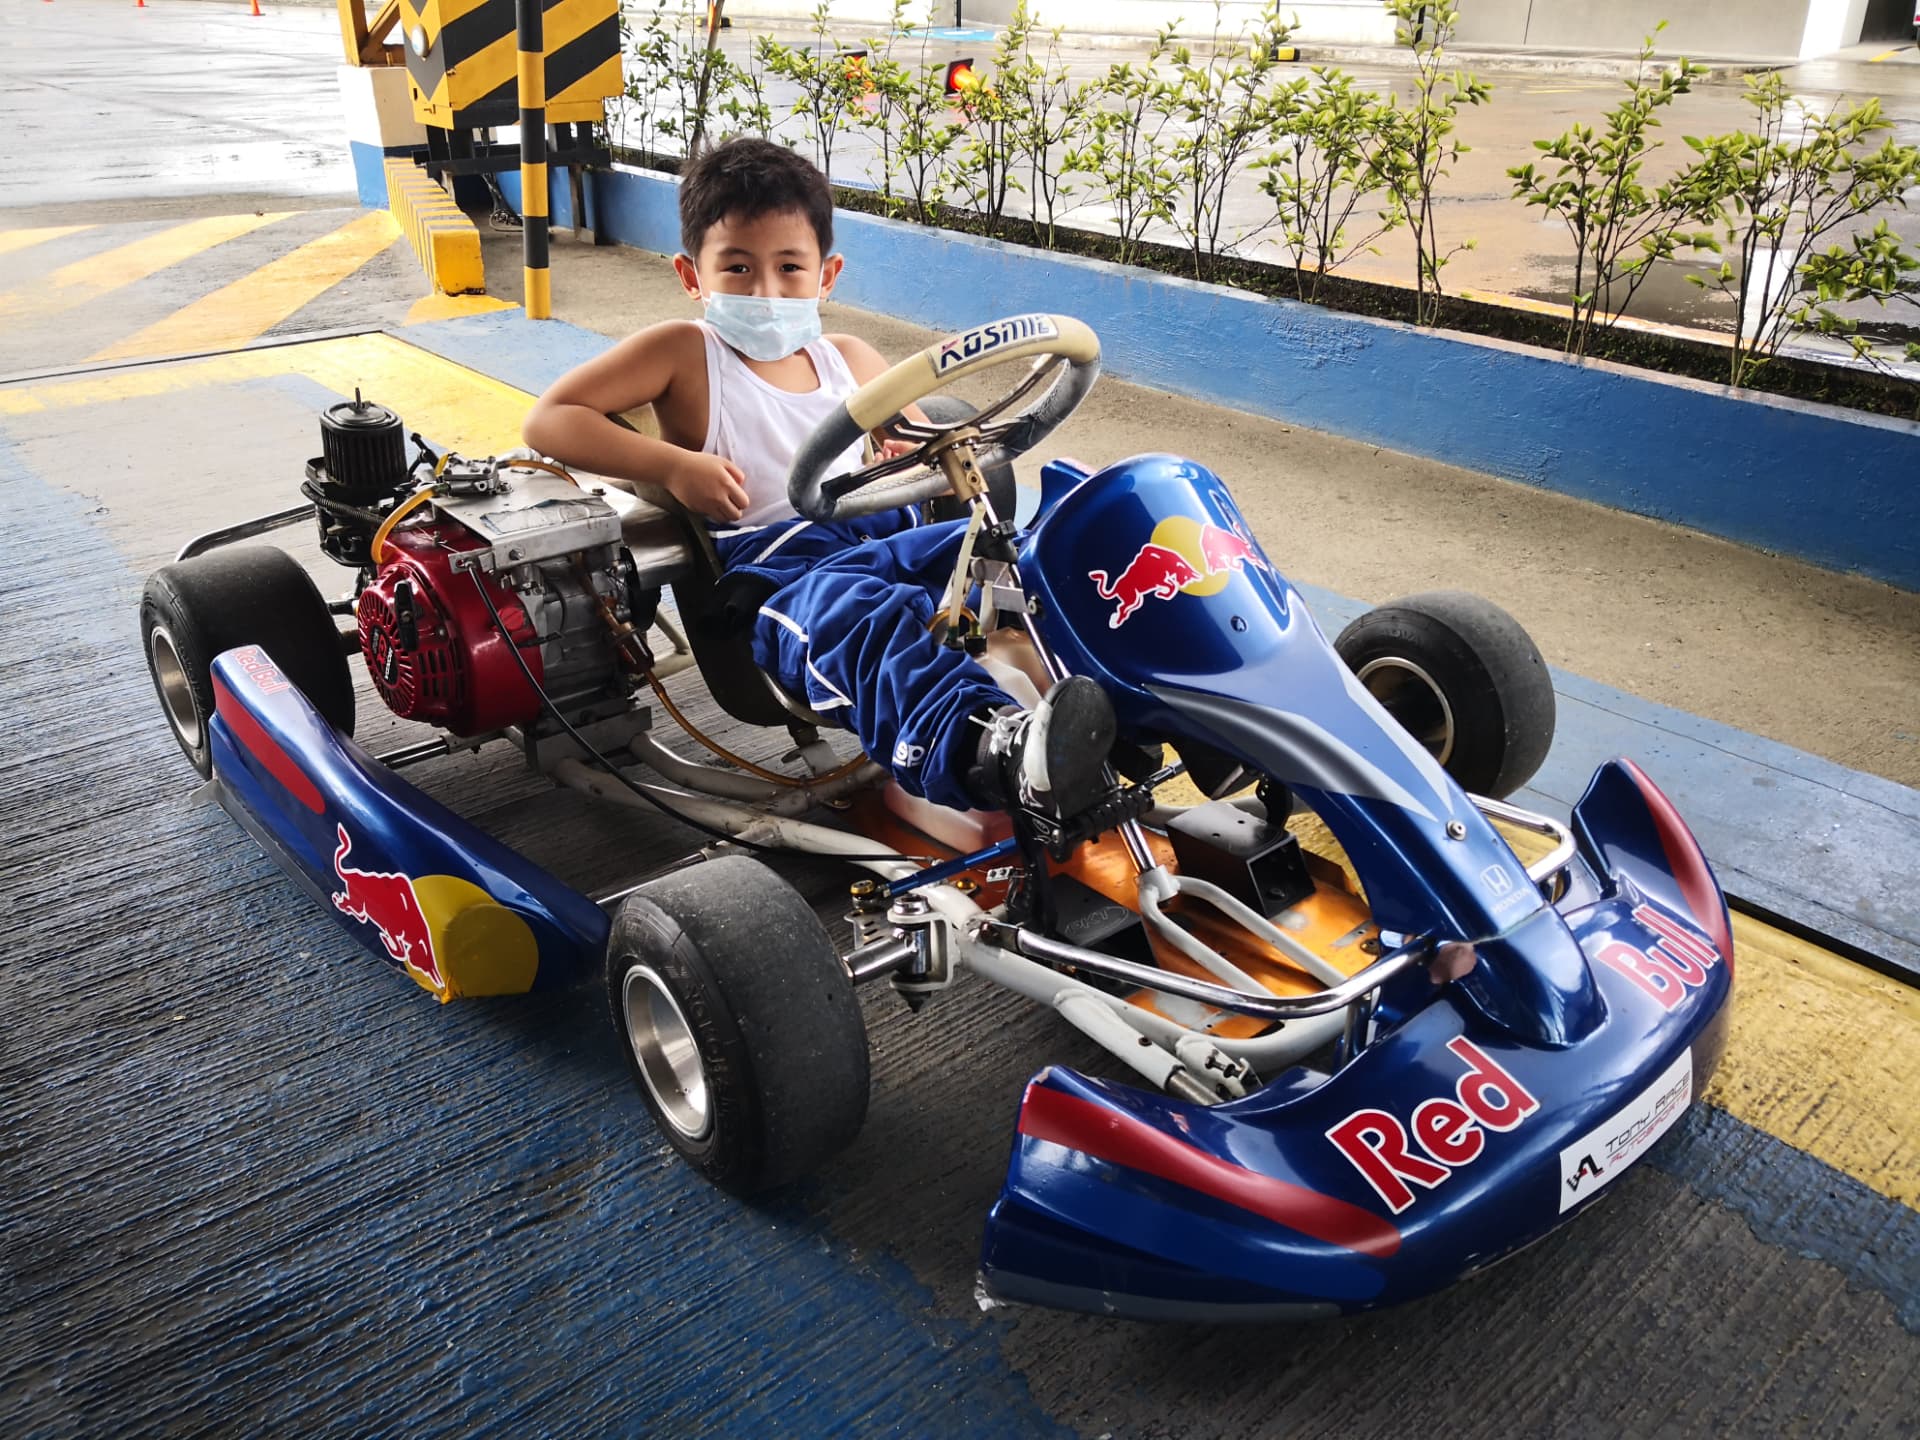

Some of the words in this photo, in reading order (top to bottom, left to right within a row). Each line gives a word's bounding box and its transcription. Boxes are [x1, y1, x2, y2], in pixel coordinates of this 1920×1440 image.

[231, 647, 273, 674] Red
[251, 668, 290, 696] Bull
[1326, 1035, 1540, 1215] Red
[1594, 904, 1720, 1012] Bull
